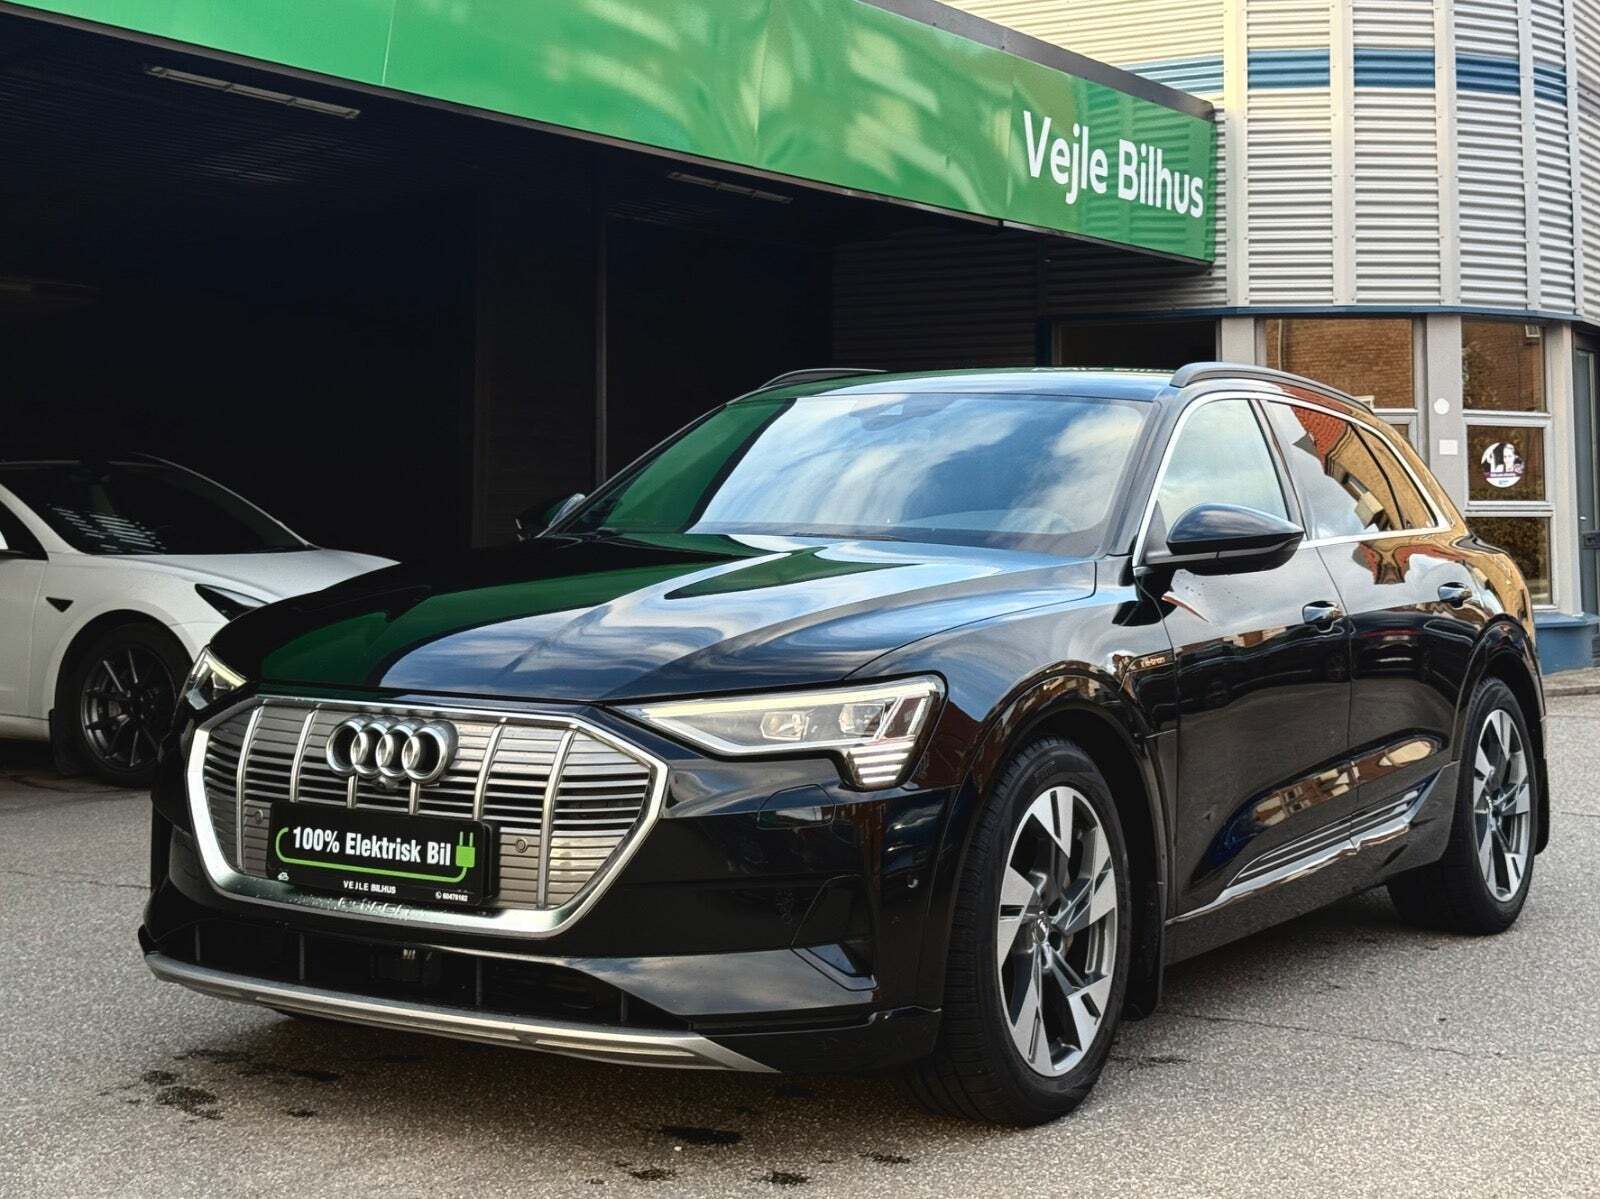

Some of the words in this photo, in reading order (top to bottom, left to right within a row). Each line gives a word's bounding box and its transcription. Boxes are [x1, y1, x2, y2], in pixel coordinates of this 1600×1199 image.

[1023, 110, 1109, 205] Vejle
[1117, 138, 1205, 219] Bilhus
[293, 826, 340, 854] 100%
[345, 831, 422, 863] Elektrisk
[426, 840, 451, 866] Bil
[343, 879, 369, 891] VEJLE
[370, 883, 397, 894] BILHUS
